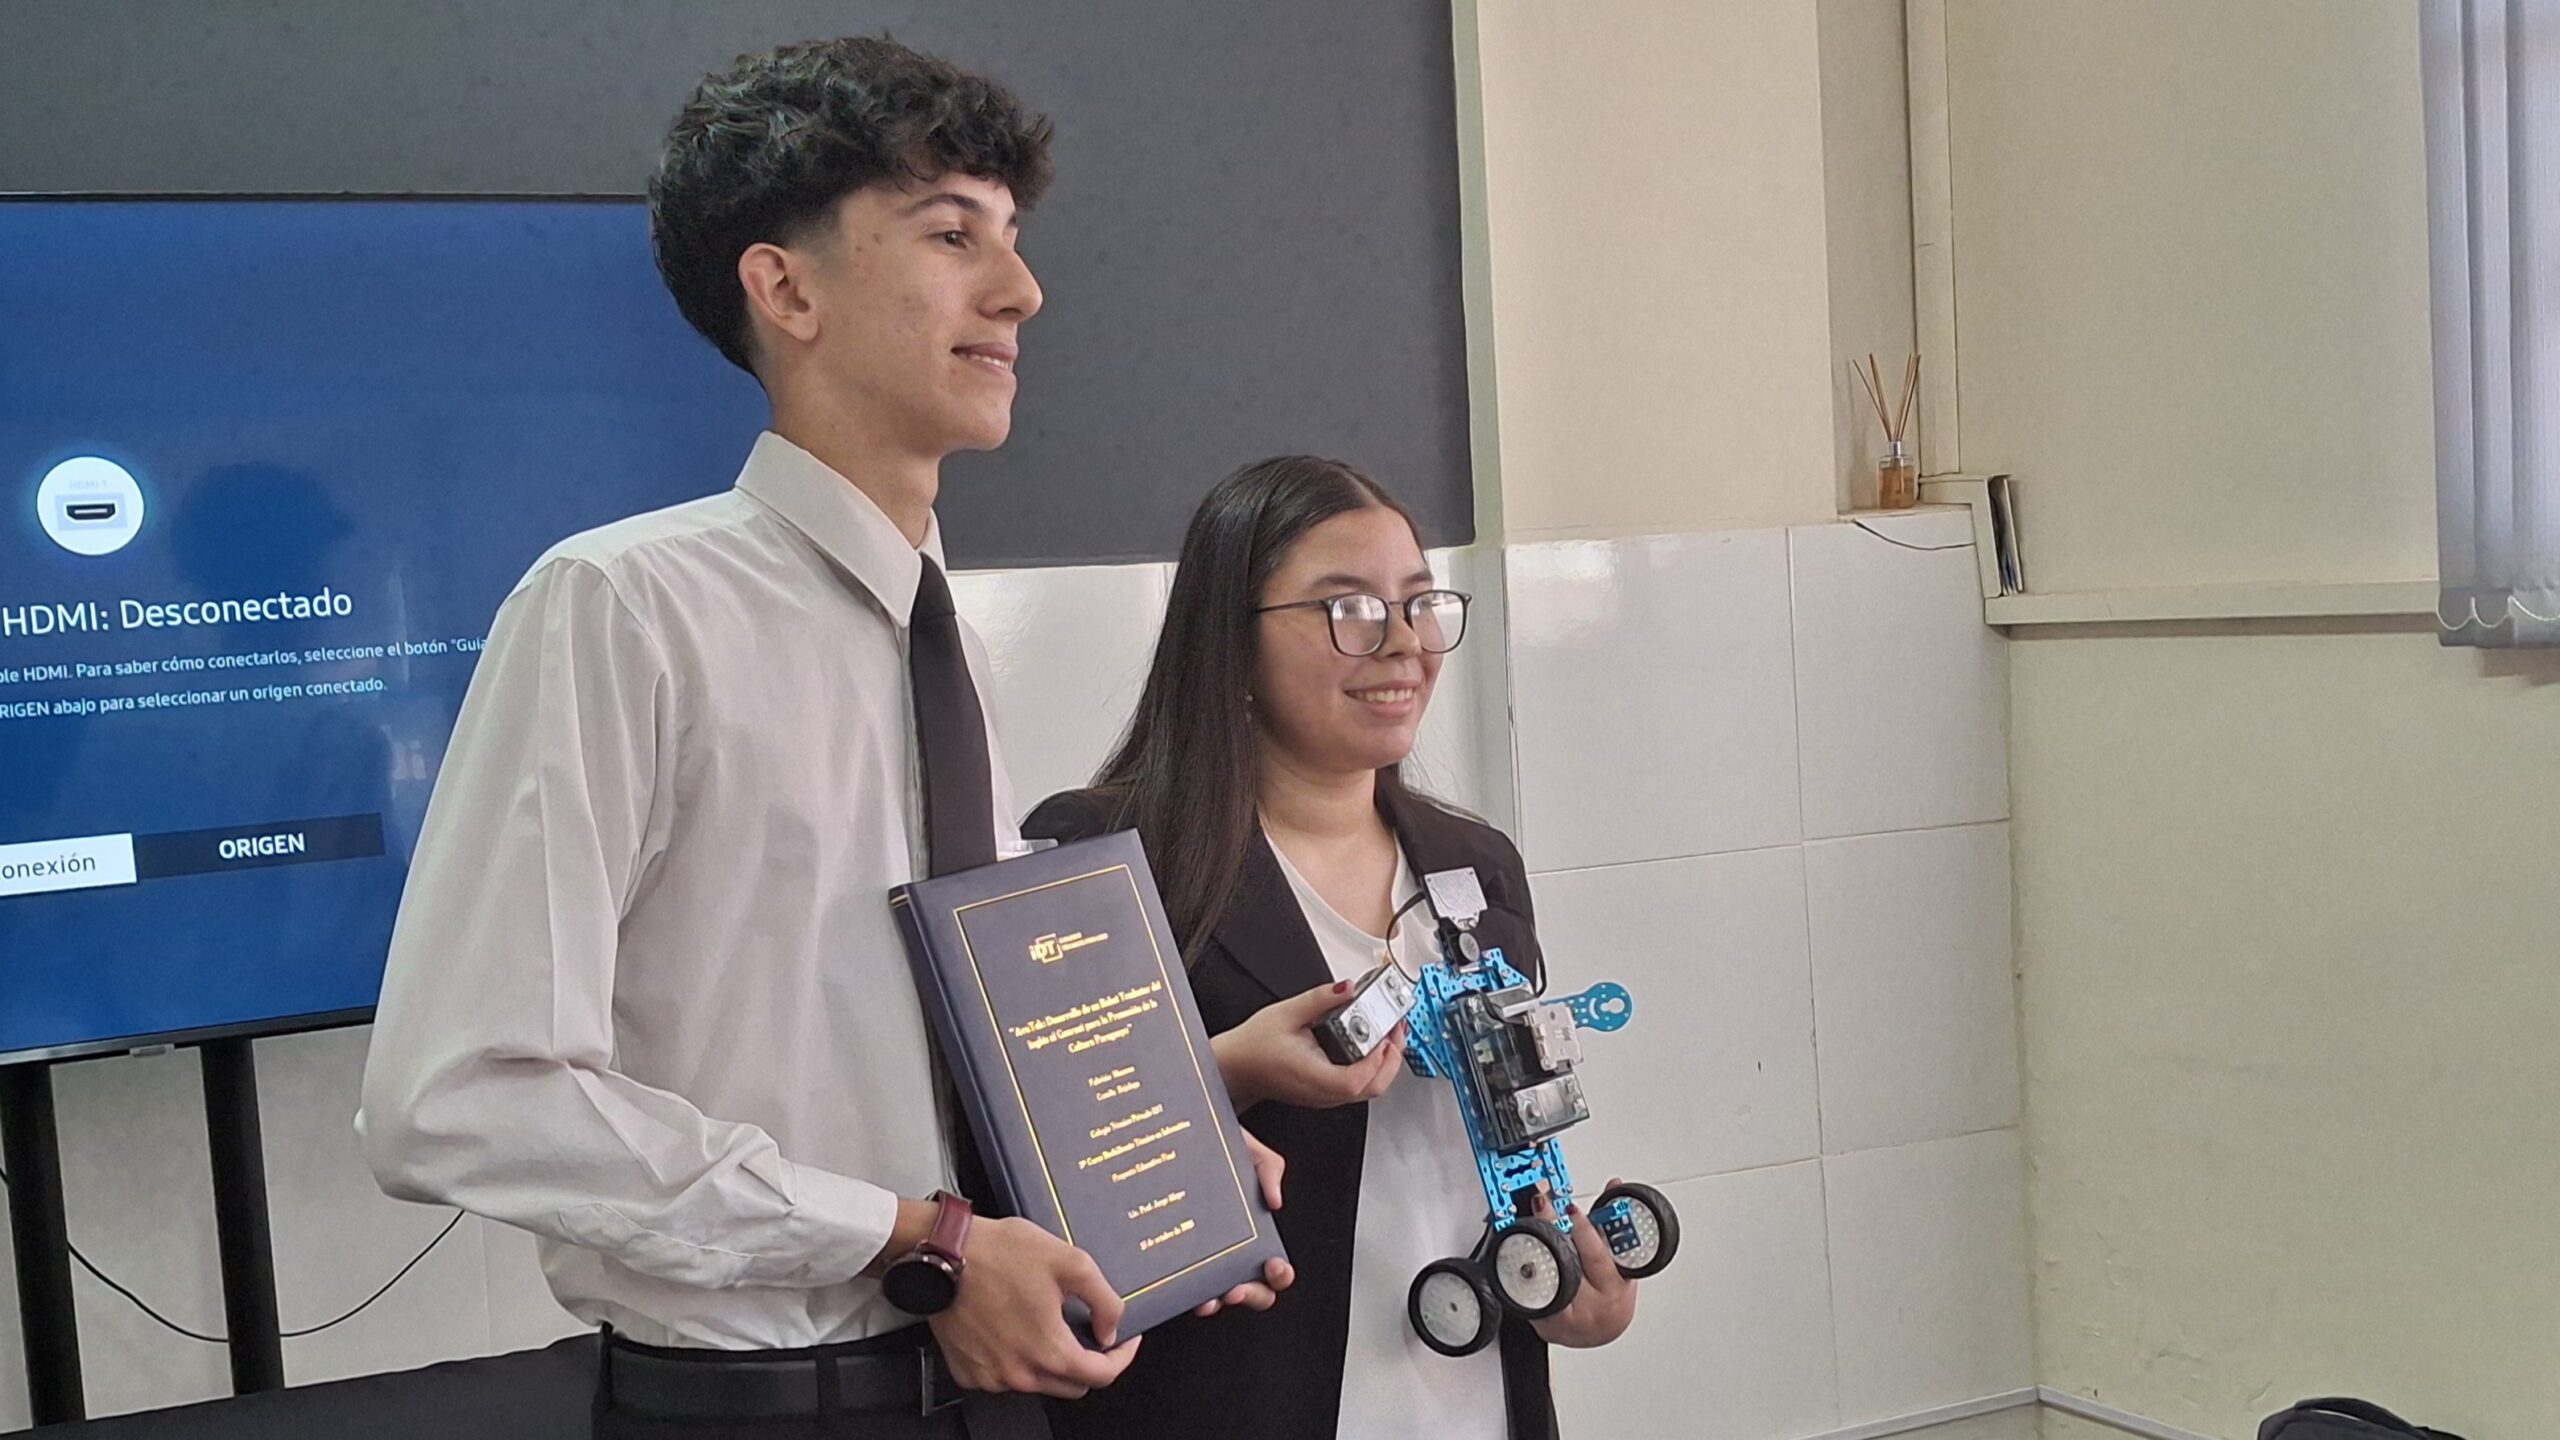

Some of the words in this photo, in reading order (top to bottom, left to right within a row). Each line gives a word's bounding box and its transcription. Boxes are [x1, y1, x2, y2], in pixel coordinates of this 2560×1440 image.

[2, 602, 109, 636] HDMI:
[119, 587, 353, 629] Desconectado
[23, 665, 73, 682] HDMI.
[76, 663, 112, 678] Para
[115, 660, 158, 675] saber
[161, 655, 204, 672] cómo
[207, 649, 302, 668] conectarlos,
[304, 645, 384, 663] seleccione
[387, 642, 401, 657] el
[404, 640, 448, 656] botón
[53, 697, 96, 716] abajo
[100, 696, 135, 714] para
[138, 689, 228, 708] seleccionar
[229, 688, 249, 701] un
[252, 683, 302, 701] origen
[306, 677, 388, 697] conectado.
[0, 853, 97, 881] onexión
[218, 832, 306, 860] ORIGEN
